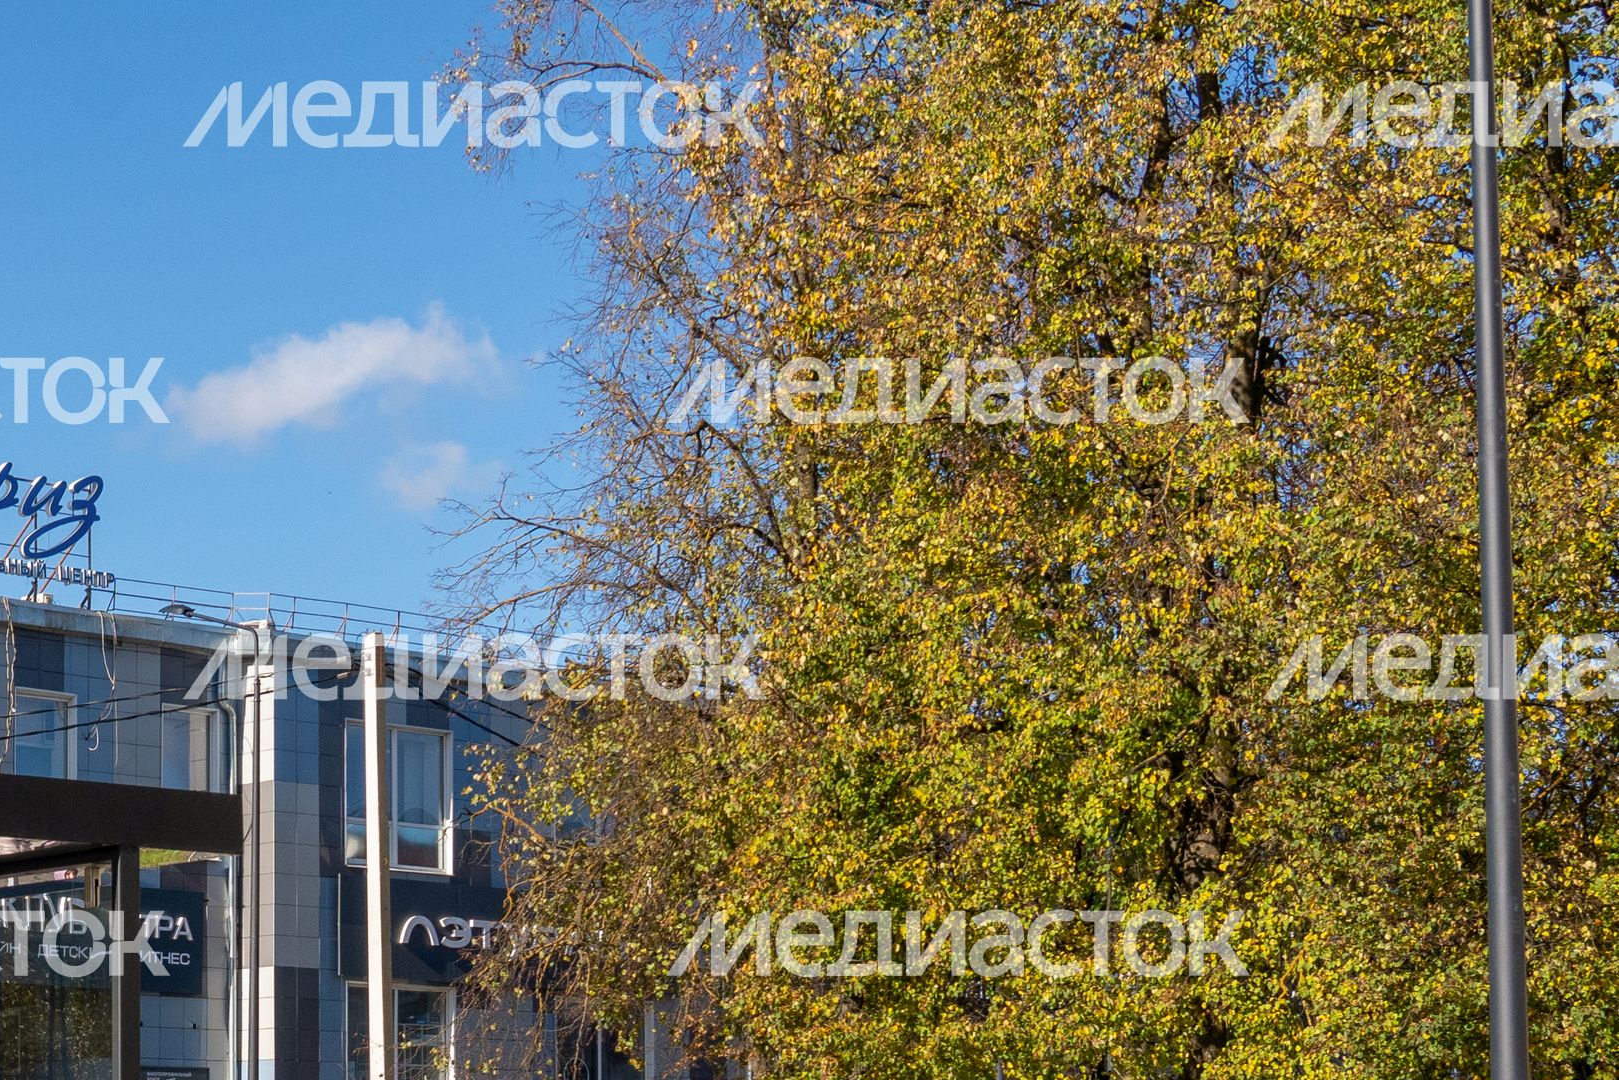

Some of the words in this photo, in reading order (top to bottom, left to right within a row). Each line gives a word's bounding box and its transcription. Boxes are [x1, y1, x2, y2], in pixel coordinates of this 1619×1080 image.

[58, 565, 116, 588] ЦЕНТР
[139, 913, 194, 942] ТРА
[139, 950, 190, 966] ИТНЕС
